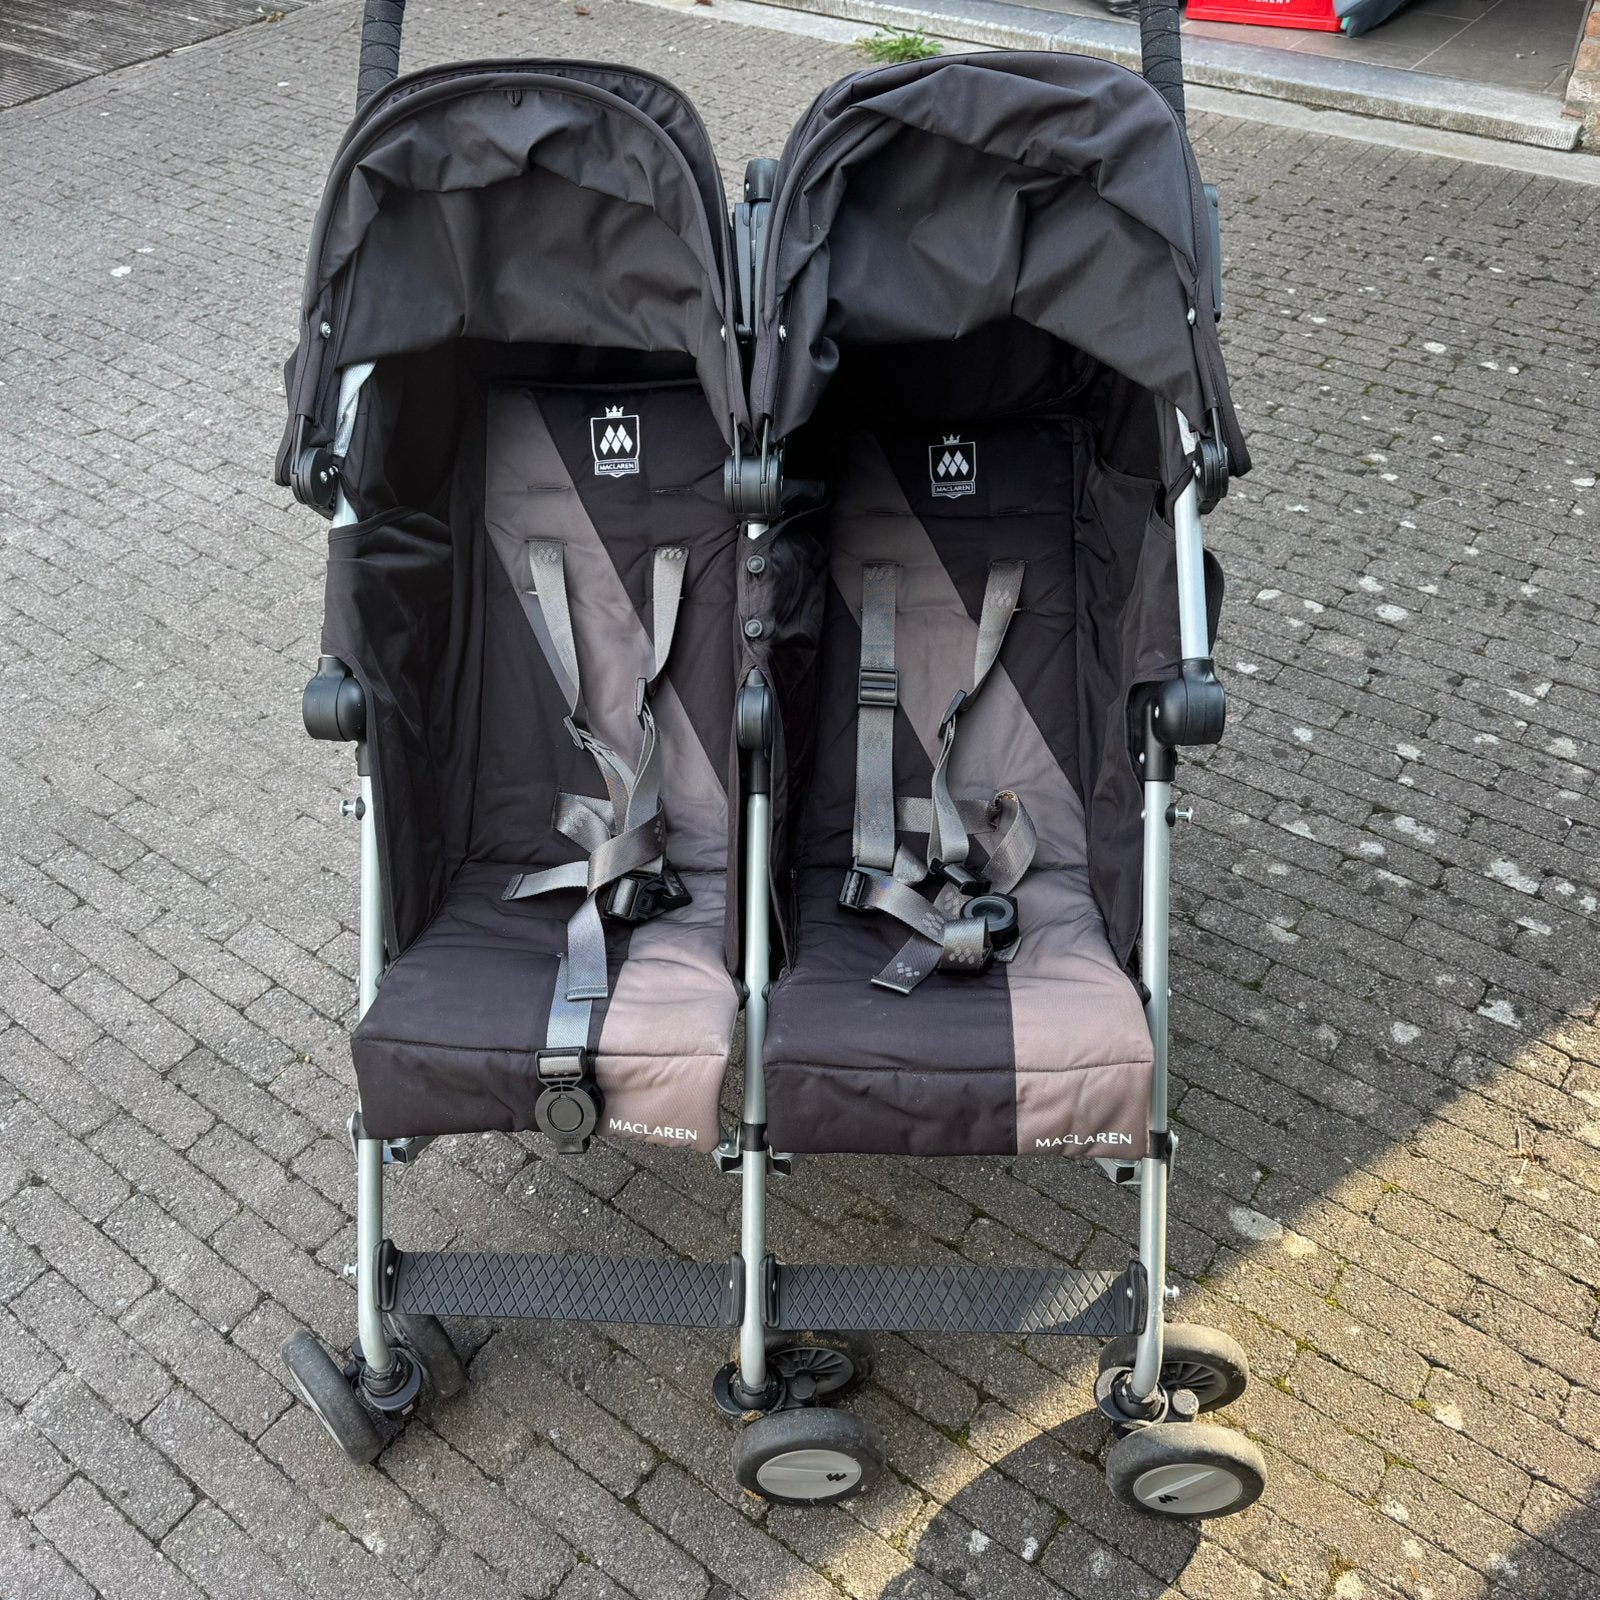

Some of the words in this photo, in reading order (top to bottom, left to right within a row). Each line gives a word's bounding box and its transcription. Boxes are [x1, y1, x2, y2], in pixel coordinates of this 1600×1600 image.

[600, 463, 634, 471] MACLAREN
[936, 485, 971, 493] MACLAREN
[609, 1118, 698, 1140] MACLAREN
[1035, 1132, 1132, 1148] MACLAREN
